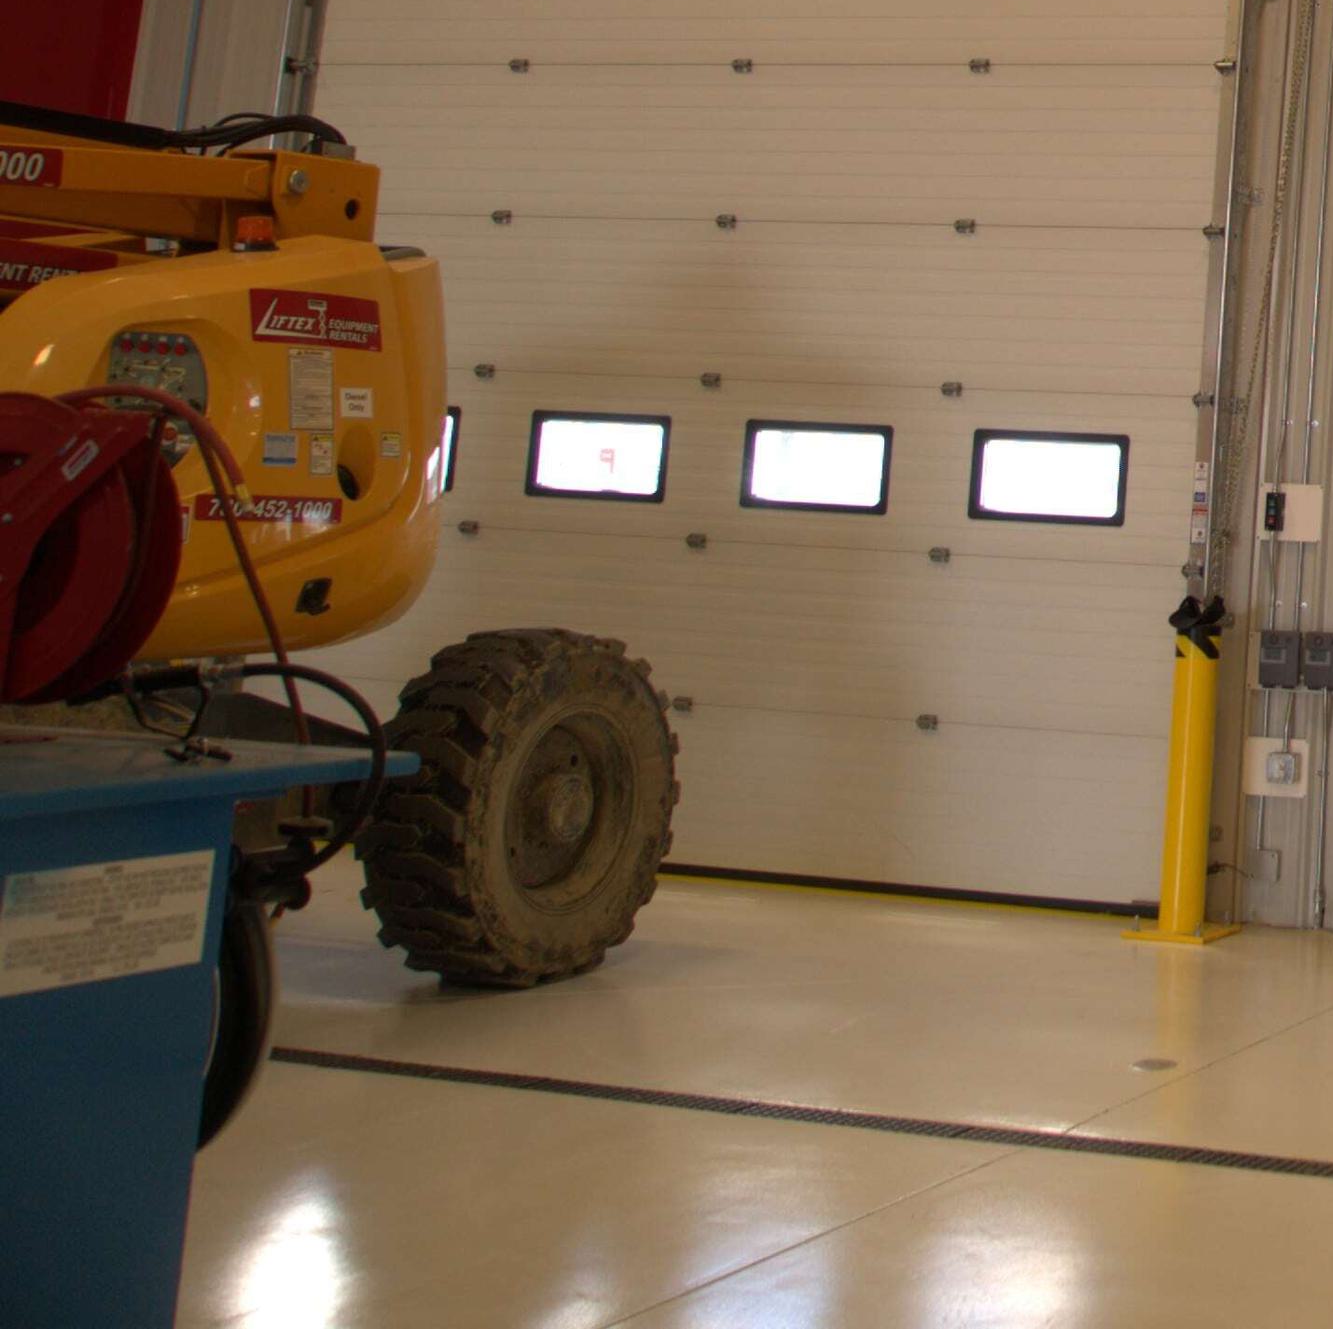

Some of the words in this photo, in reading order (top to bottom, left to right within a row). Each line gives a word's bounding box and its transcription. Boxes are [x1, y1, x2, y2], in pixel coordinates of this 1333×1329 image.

[255, 298, 321, 338] LIFTEX
[328, 319, 379, 334] EQUIPMENT
[328, 332, 369, 343] RENTALS
